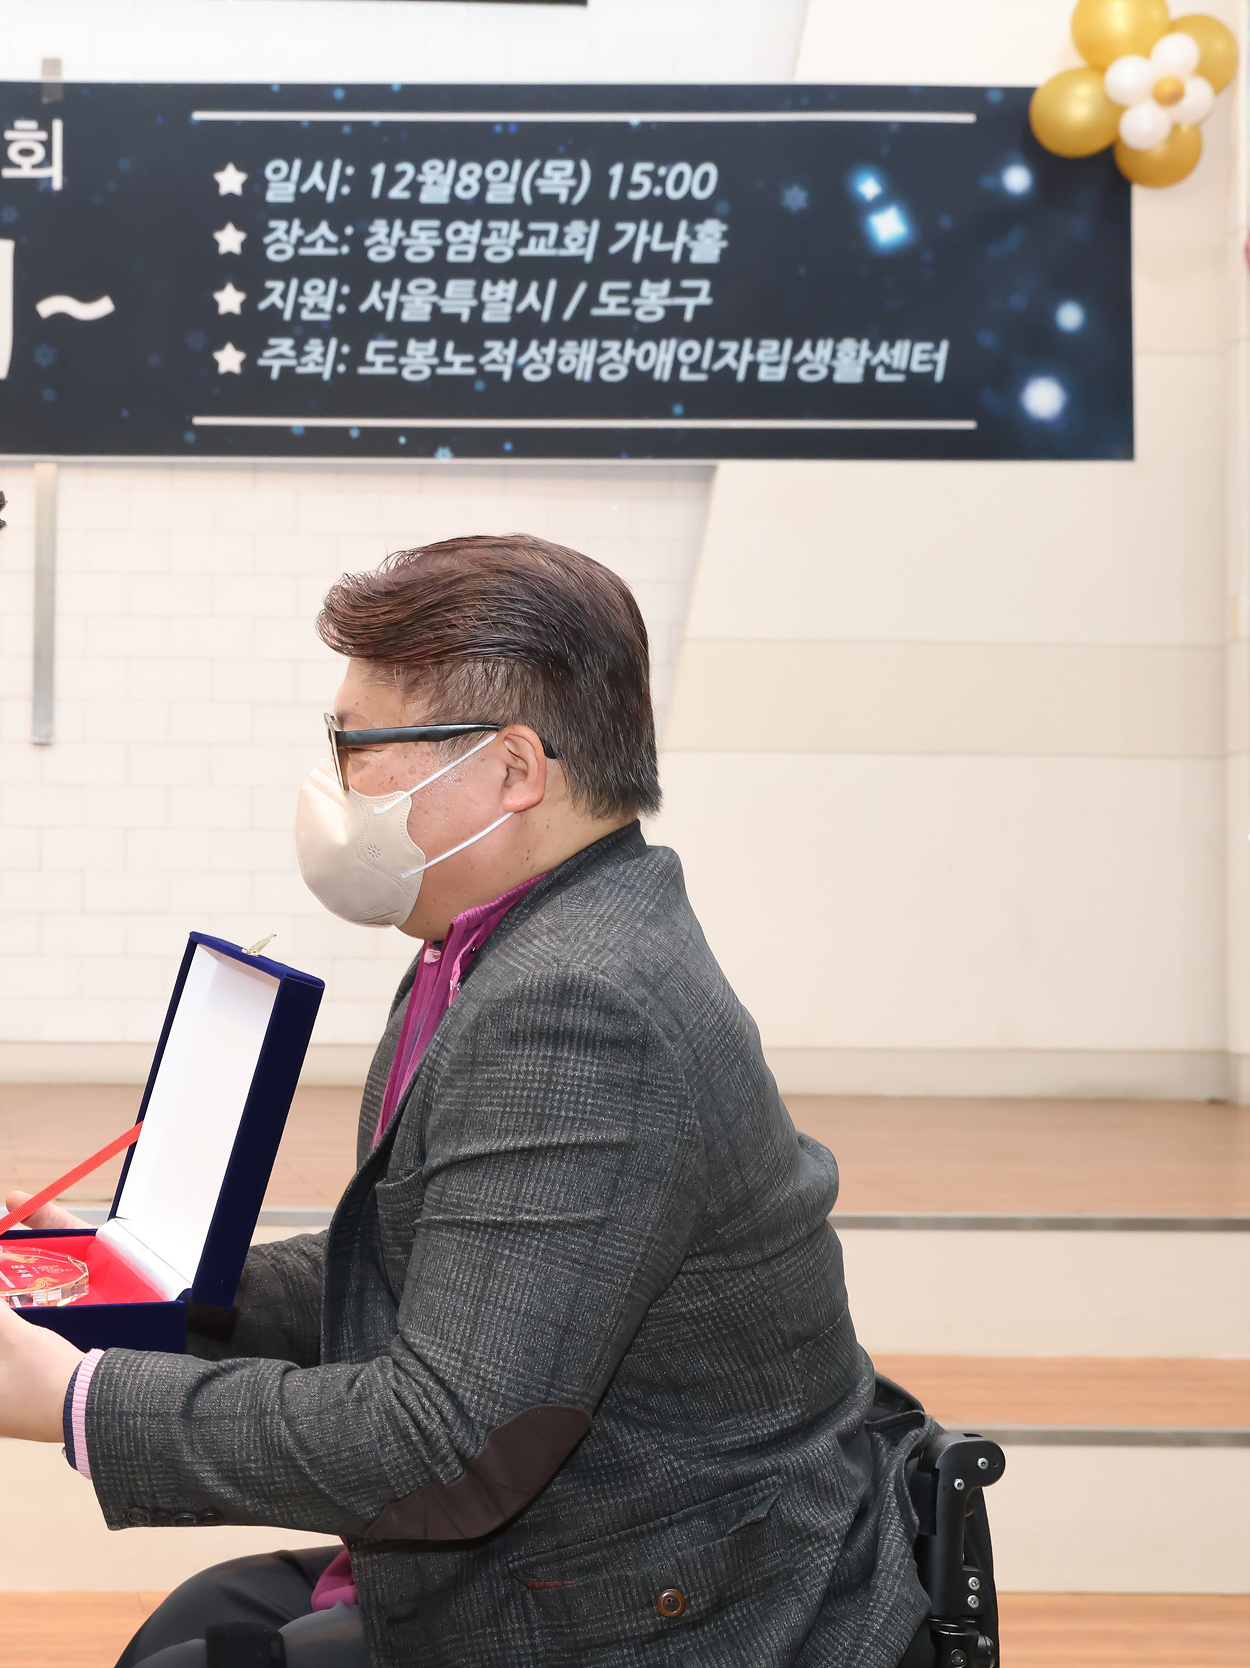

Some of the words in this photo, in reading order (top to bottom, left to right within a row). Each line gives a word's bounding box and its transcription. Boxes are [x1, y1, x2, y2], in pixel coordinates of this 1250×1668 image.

[264, 159, 354, 202] 일시:
[371, 159, 591, 204] 12월8일(목)
[608, 162, 718, 200] 15:00
[262, 219, 353, 262] 장소:
[364, 219, 599, 263] 창동염광교회
[609, 219, 728, 264] 가나홀
[258, 278, 349, 321] 지원:
[359, 278, 557, 322] 서울특별시
[562, 281, 587, 321] /
[591, 279, 712, 322] 도봉구
[257, 338, 350, 381] 주최:
[358, 338, 949, 383] 도봉노적성해장애인자립생활센터
